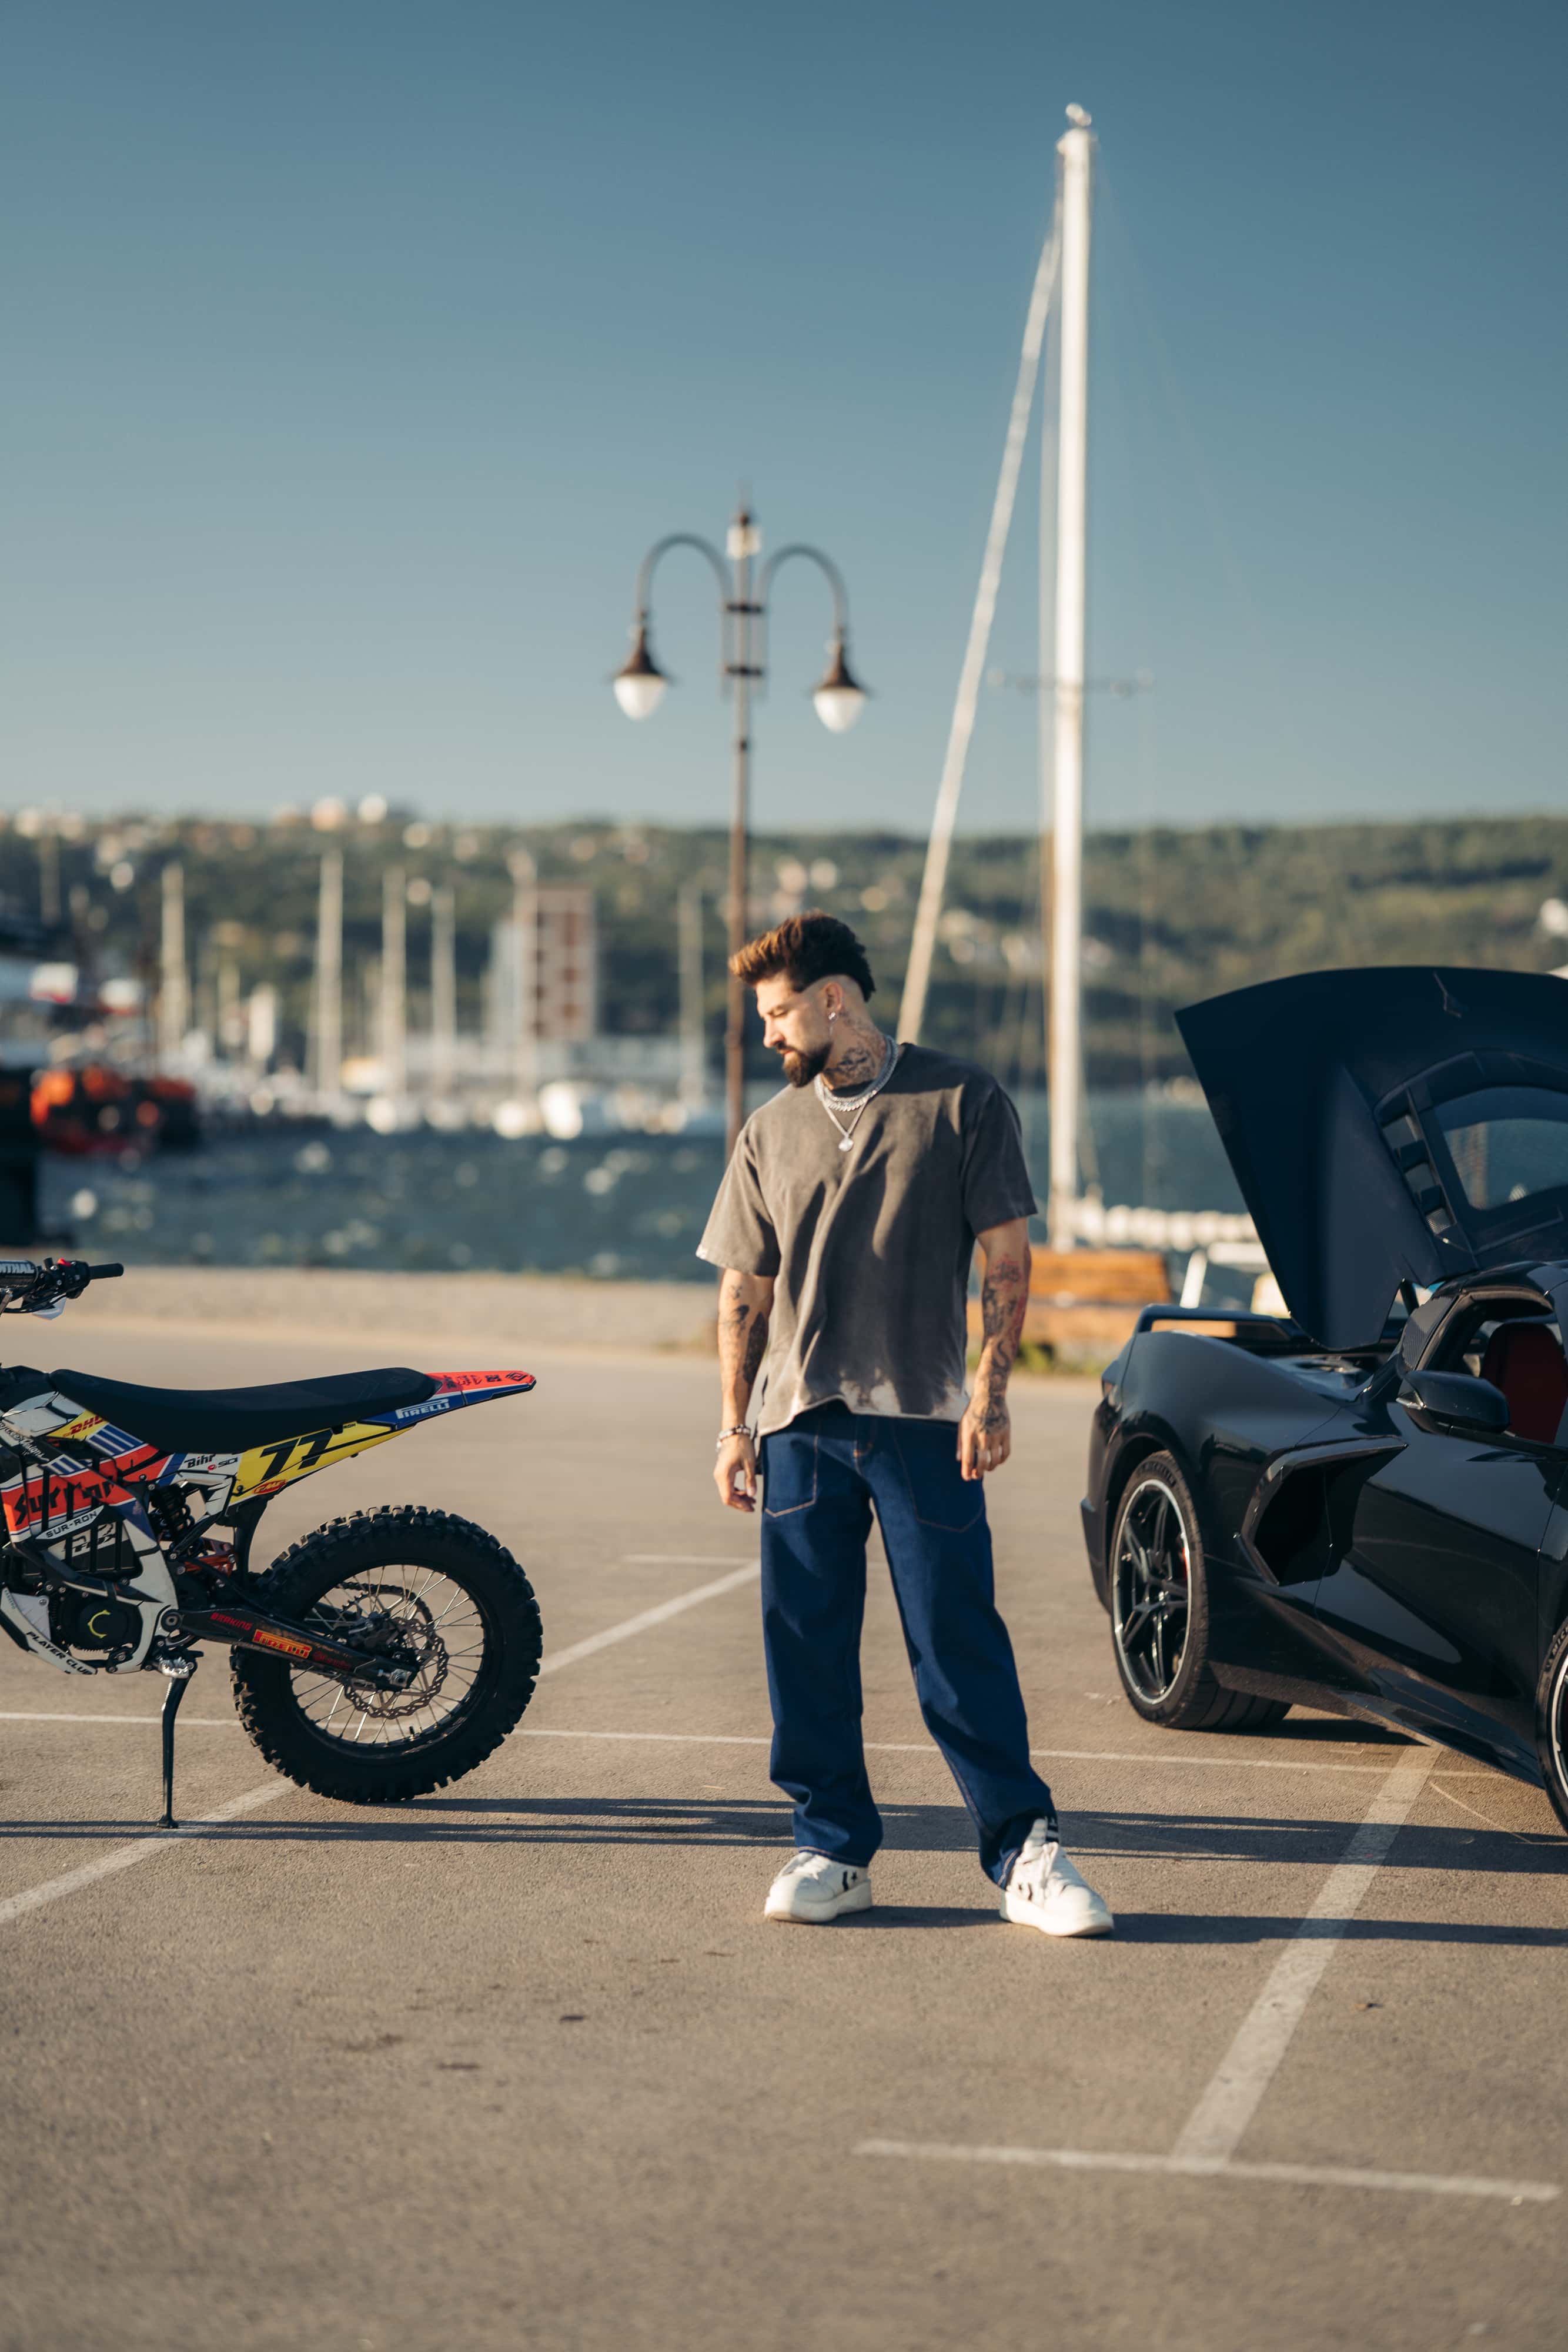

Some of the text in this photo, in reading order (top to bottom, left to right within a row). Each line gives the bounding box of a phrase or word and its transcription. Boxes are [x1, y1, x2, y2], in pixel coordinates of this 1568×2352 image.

[394, 1398, 450, 1420] PIRELLI
[69, 1415, 104, 1435] DHL
[184, 1453, 216, 1469] Bihr
[259, 1428, 334, 1482] 77
[45, 1511, 98, 1538] SUR-RON
[26, 1631, 93, 1675] PLAYER CLUB
[252, 1629, 312, 1659] PIRELLI
